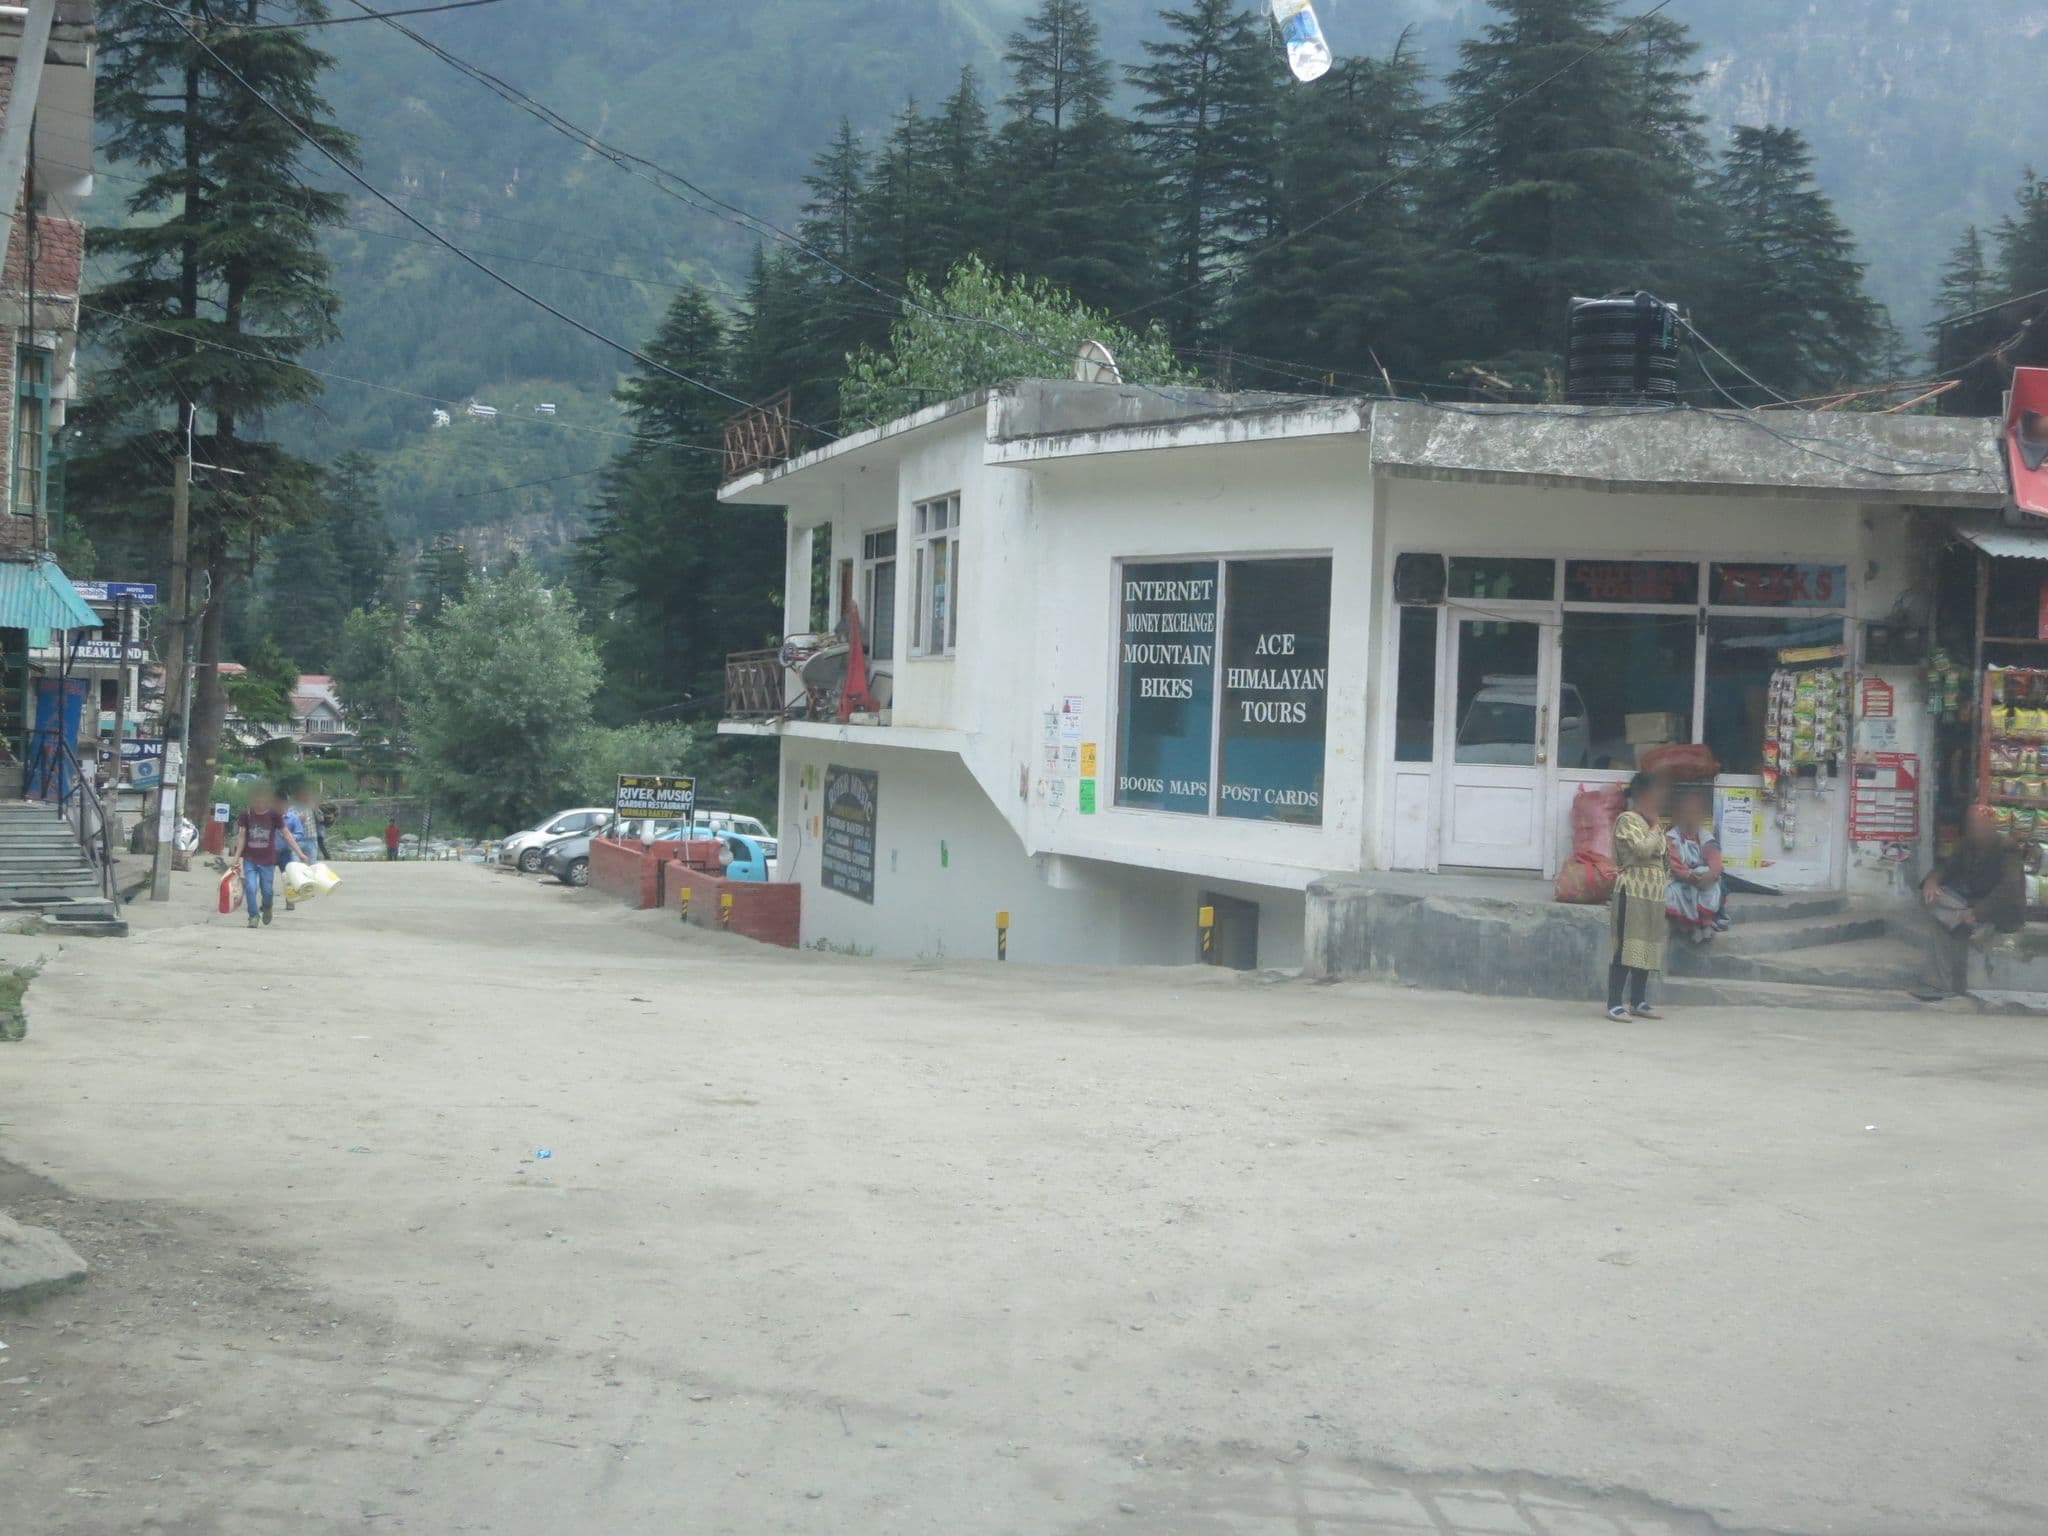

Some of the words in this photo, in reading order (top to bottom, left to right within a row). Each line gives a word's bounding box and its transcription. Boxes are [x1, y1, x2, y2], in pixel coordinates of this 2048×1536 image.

[1125, 580, 1213, 602] INTERNET
[1127, 613, 1160, 633] MONEY
[1162, 613, 1215, 633] EXCHANGE
[1123, 644, 1212, 665] MOUNTAIN
[1255, 634, 1295, 655] ACE
[1140, 678, 1193, 699] BIKES
[1227, 668, 1326, 690] HIMALAYAN
[1241, 701, 1307, 723] TOURS
[620, 788, 655, 801] RIVER
[657, 790, 693, 802] MUSIC
[1120, 776, 1164, 793] BOOKS
[1170, 780, 1208, 797] MAPS
[1221, 784, 1261, 803] POST
[1265, 788, 1319, 807] CARDS
[618, 800, 646, 808] GARDEN
[647, 801, 691, 810] RESTAURANT
